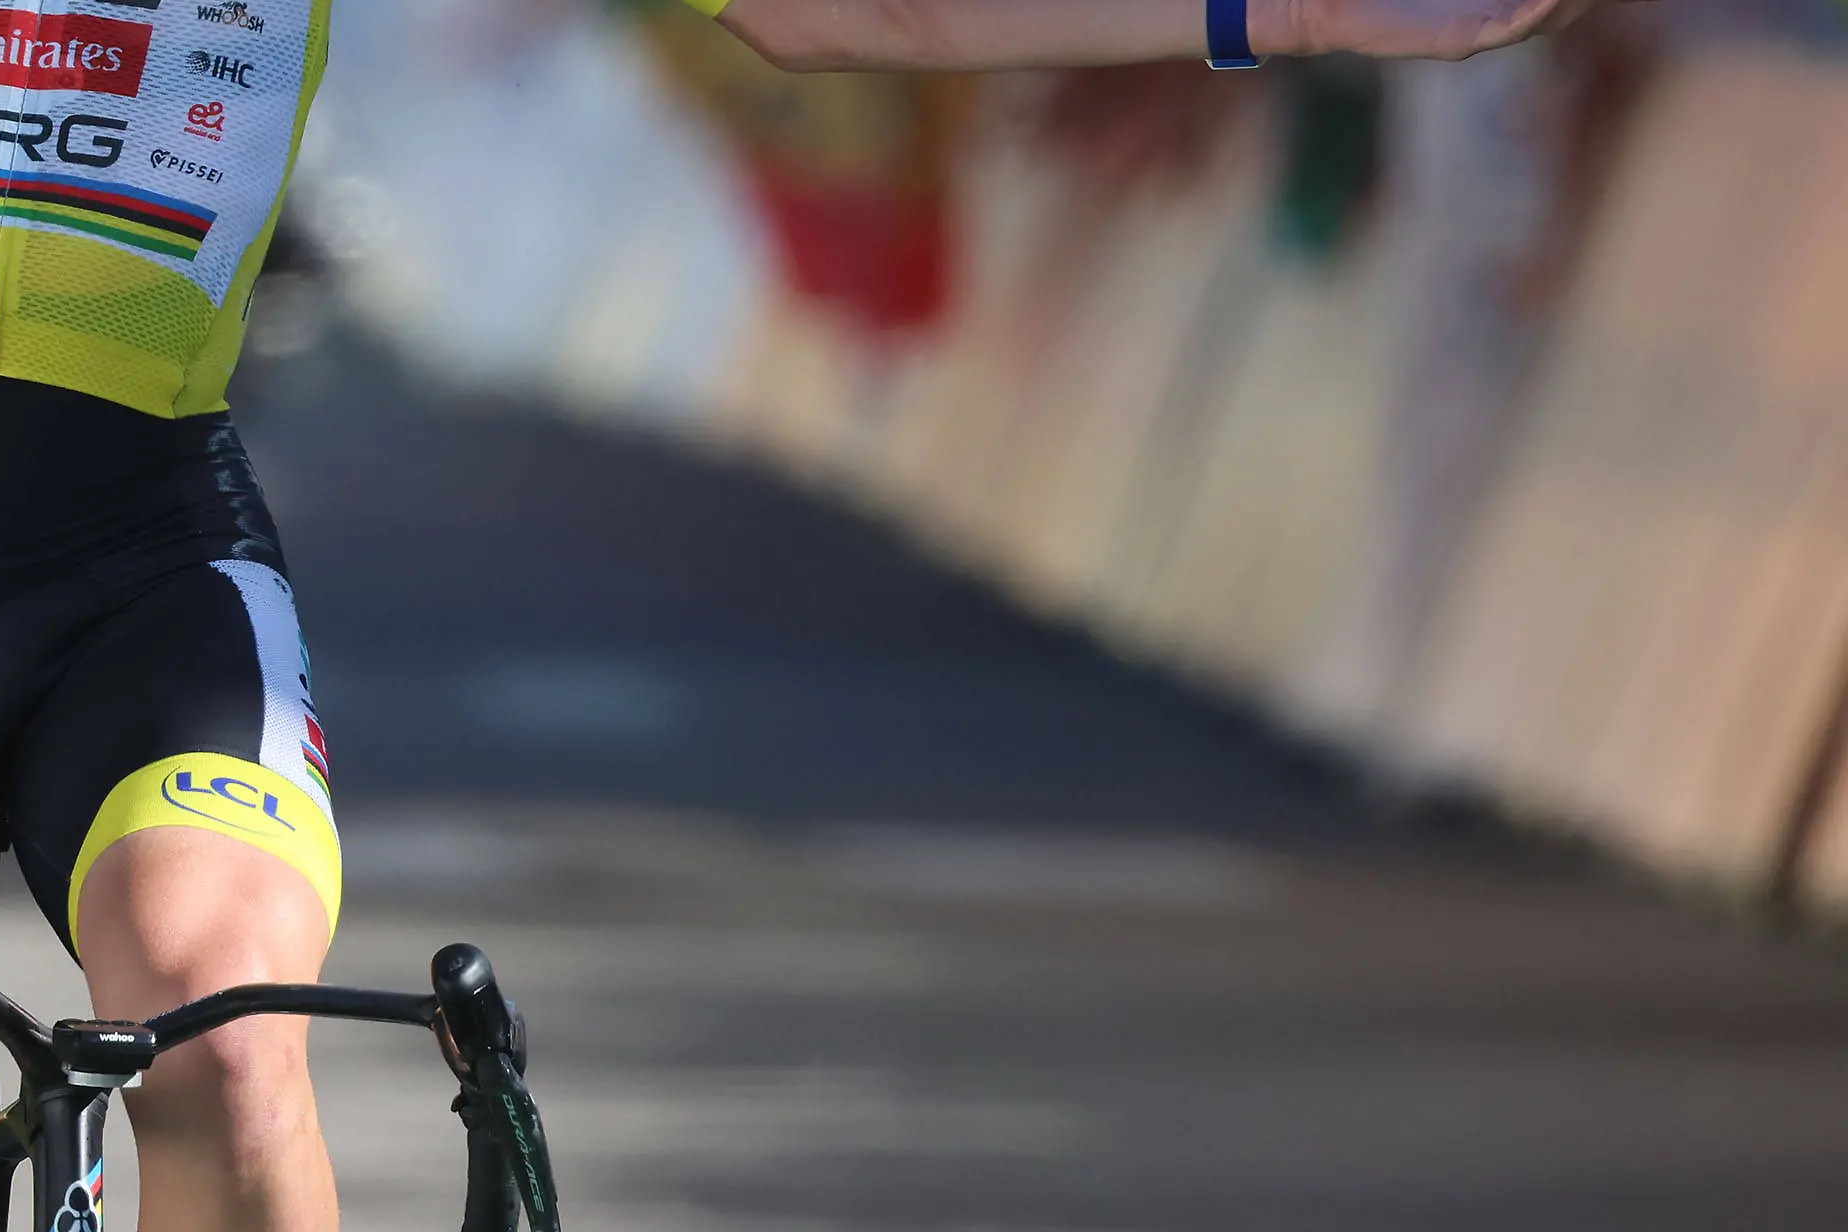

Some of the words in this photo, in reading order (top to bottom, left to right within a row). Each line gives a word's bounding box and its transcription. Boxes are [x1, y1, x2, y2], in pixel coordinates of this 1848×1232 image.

[212, 55, 255, 89] IHC
[167, 158, 224, 185] PISSEI
[175, 770, 296, 832] LCL
[99, 1031, 136, 1043] wahoo
